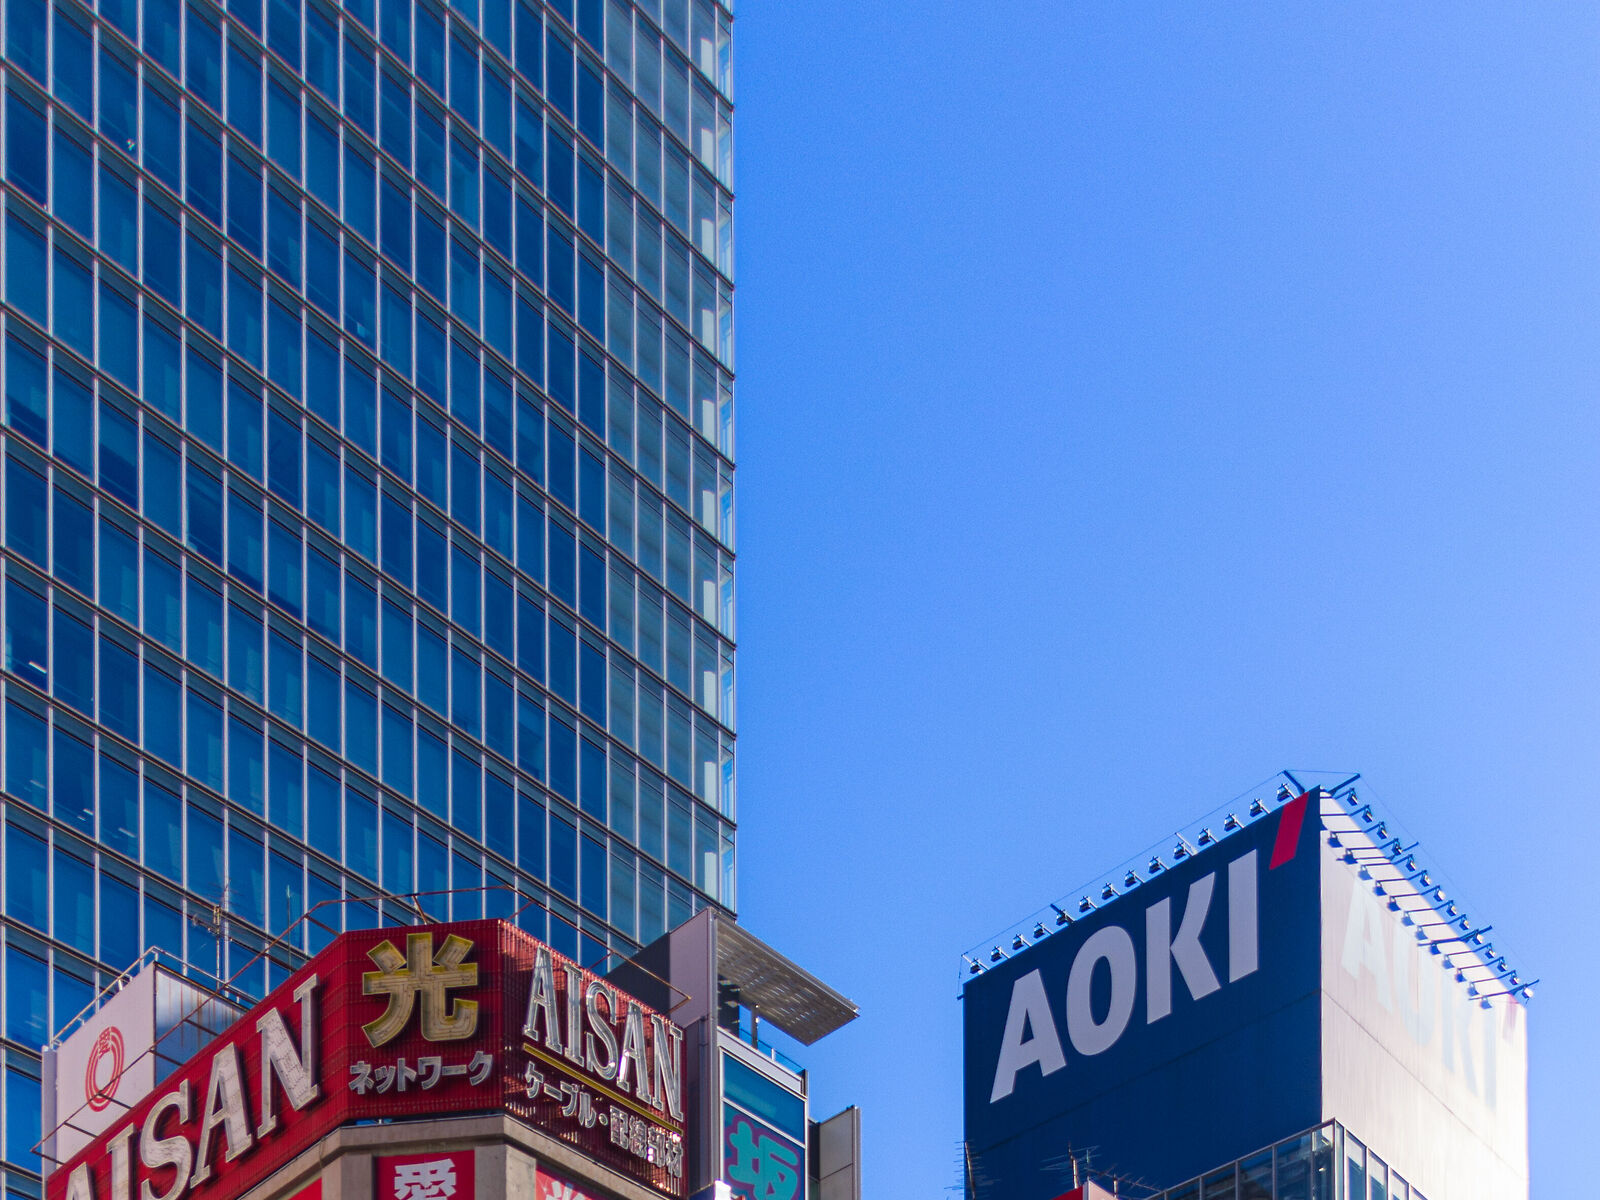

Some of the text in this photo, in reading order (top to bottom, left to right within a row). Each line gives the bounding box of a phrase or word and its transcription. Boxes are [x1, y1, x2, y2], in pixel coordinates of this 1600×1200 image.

[362, 932, 478, 1047] 光
[523, 946, 684, 1122] AISAN
[990, 849, 1259, 1103] AOKI
[348, 1050, 493, 1095] ネットワーク
[524, 1061, 683, 1180] ケーブル・配線部材
